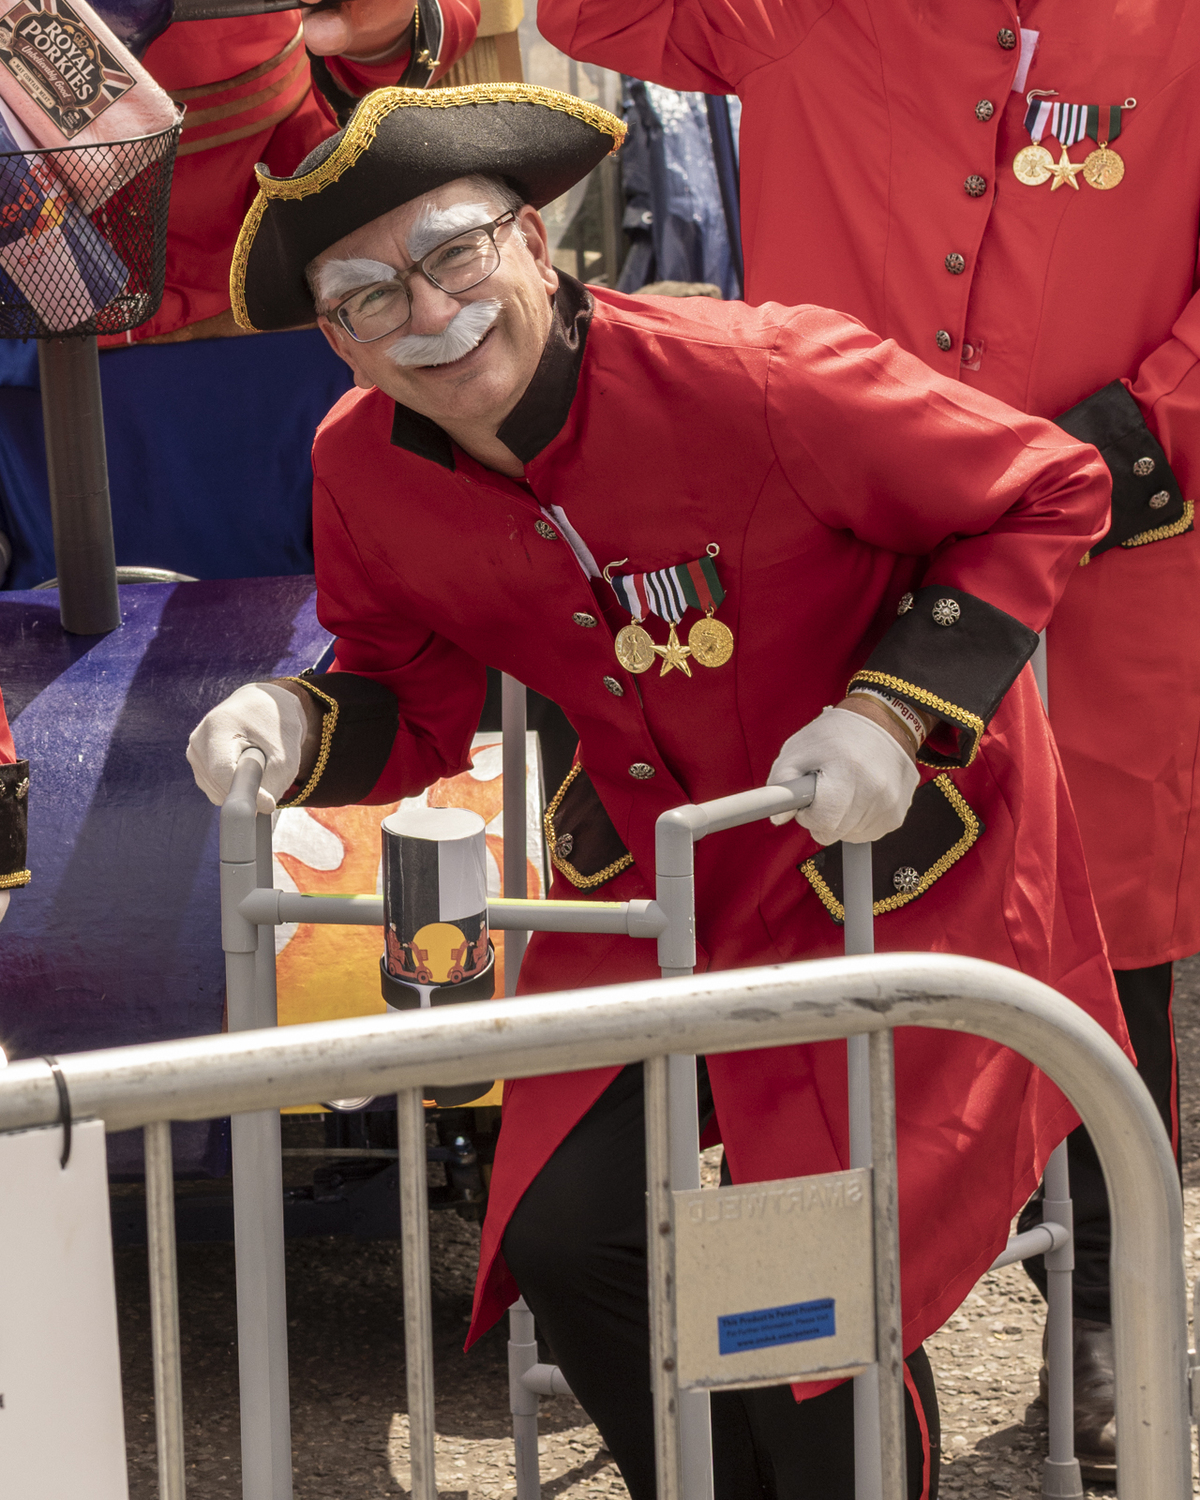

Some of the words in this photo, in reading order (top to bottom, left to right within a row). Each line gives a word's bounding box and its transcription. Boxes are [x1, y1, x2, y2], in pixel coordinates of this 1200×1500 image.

[19, 20, 93, 100] PORKIES
[21, 45, 58, 81] Unbelievably
[54, 80, 71, 98] Good
[43, 20, 95, 80] ROYAL
[15, 63, 24, 73] MAY
[22, 71, 40, 92] CONTAIN
[39, 90, 50, 103] MEAT
